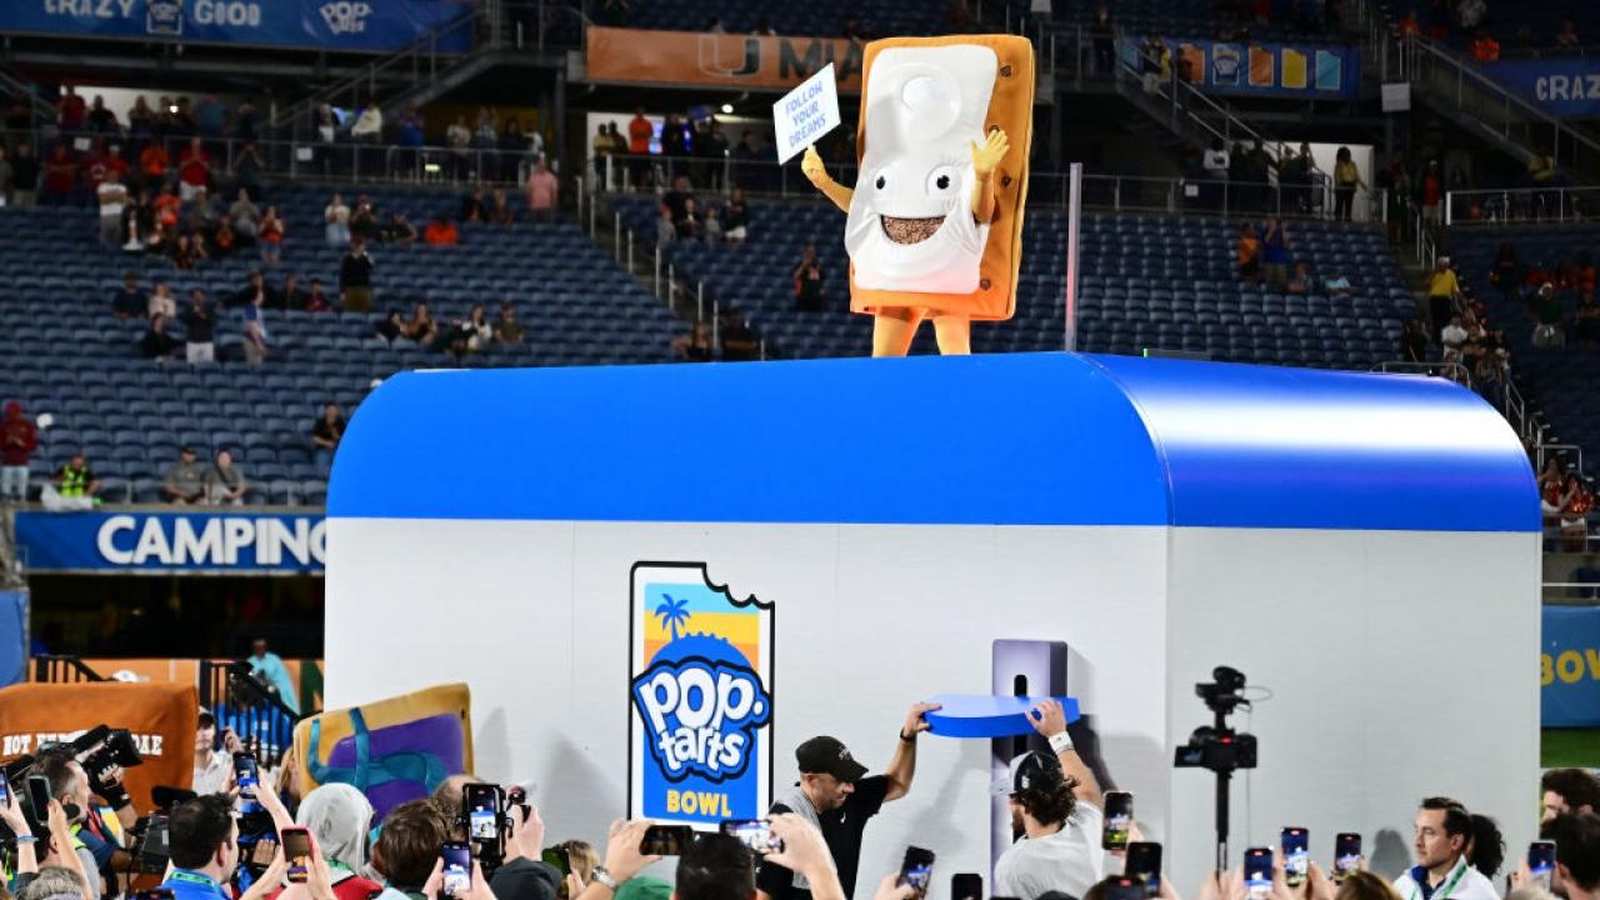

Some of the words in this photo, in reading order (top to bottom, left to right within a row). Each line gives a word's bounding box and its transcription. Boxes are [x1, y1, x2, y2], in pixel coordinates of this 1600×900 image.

[785, 80, 823, 115] FOLLOW
[792, 101, 819, 126] YOUR
[789, 113, 826, 147] DREAMS
[3, 735, 31, 755] NOT
[667, 789, 732, 817] BOWL
